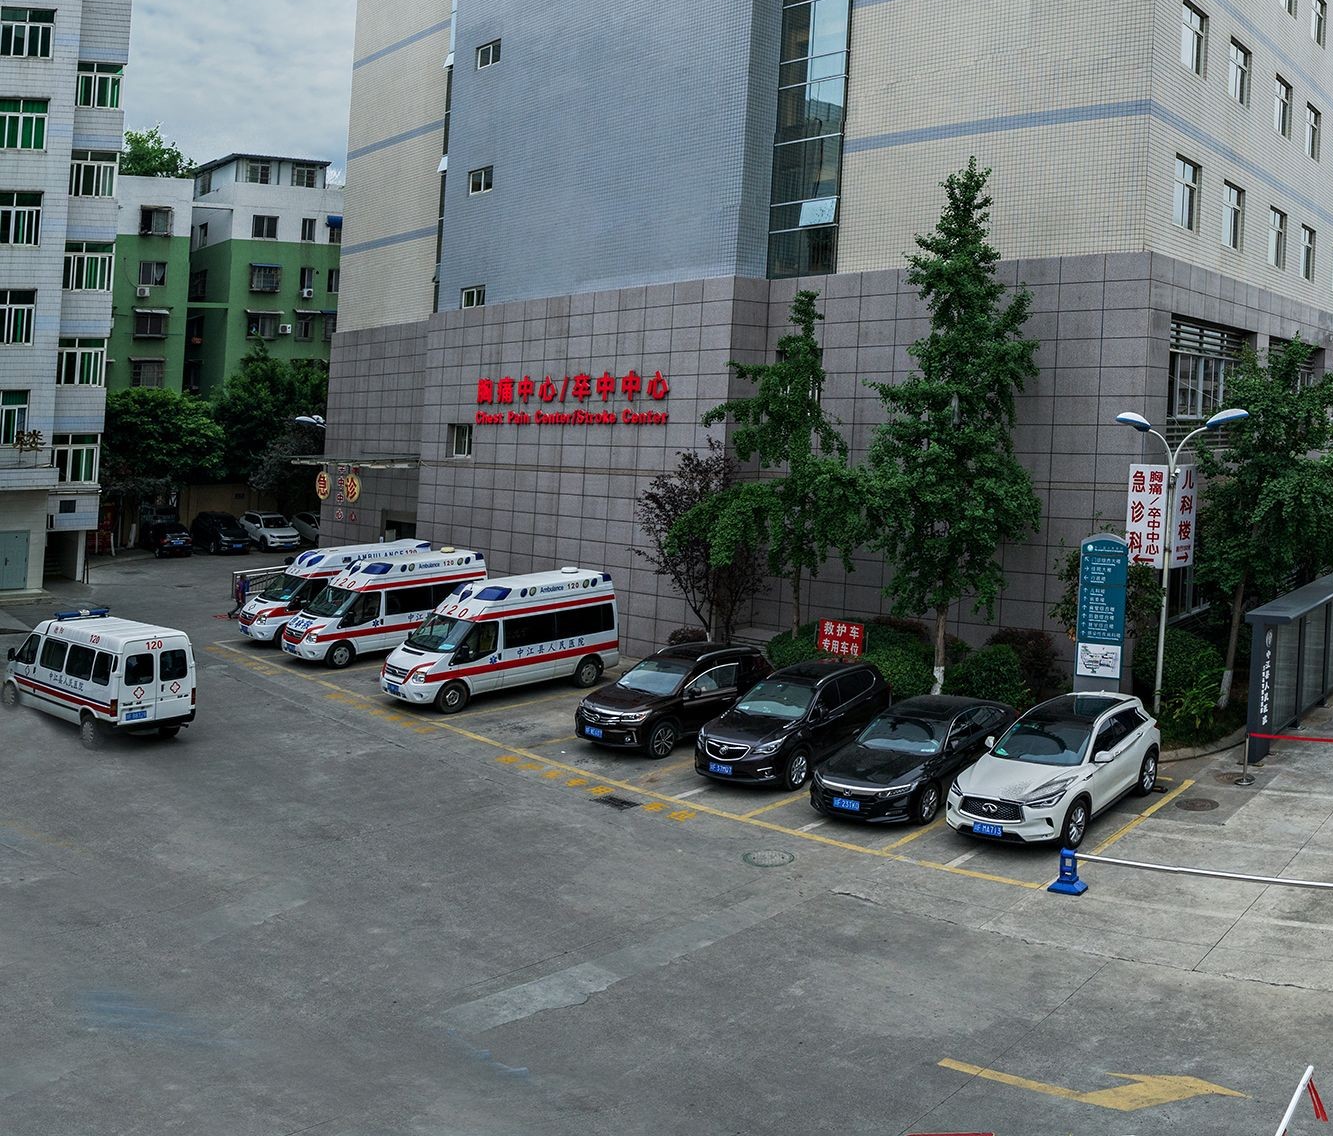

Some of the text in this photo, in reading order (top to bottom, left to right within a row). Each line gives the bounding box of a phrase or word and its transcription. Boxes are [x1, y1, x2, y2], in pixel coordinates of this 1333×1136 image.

[476, 370, 670, 405] 胸痛中心/卒中中心
[475, 408, 669, 426] Chest Pain Center/Stroke Center
[1128, 470, 1146, 554] 急诊科
[1145, 470, 1164, 555] 胸痛/卒中中心
[1177, 469, 1194, 541] 儿科楼
[418, 559, 441, 569] Ambulance
[333, 576, 356, 588] 120
[539, 582, 580, 594] Ambulance 120
[442, 603, 469, 619] 120
[823, 620, 859, 639] 救护车
[89, 634, 101, 644] 120
[146, 640, 163, 651] 120
[516, 636, 586, 658] 中江县人民医院
[822, 638, 859, 656] 专用车位
